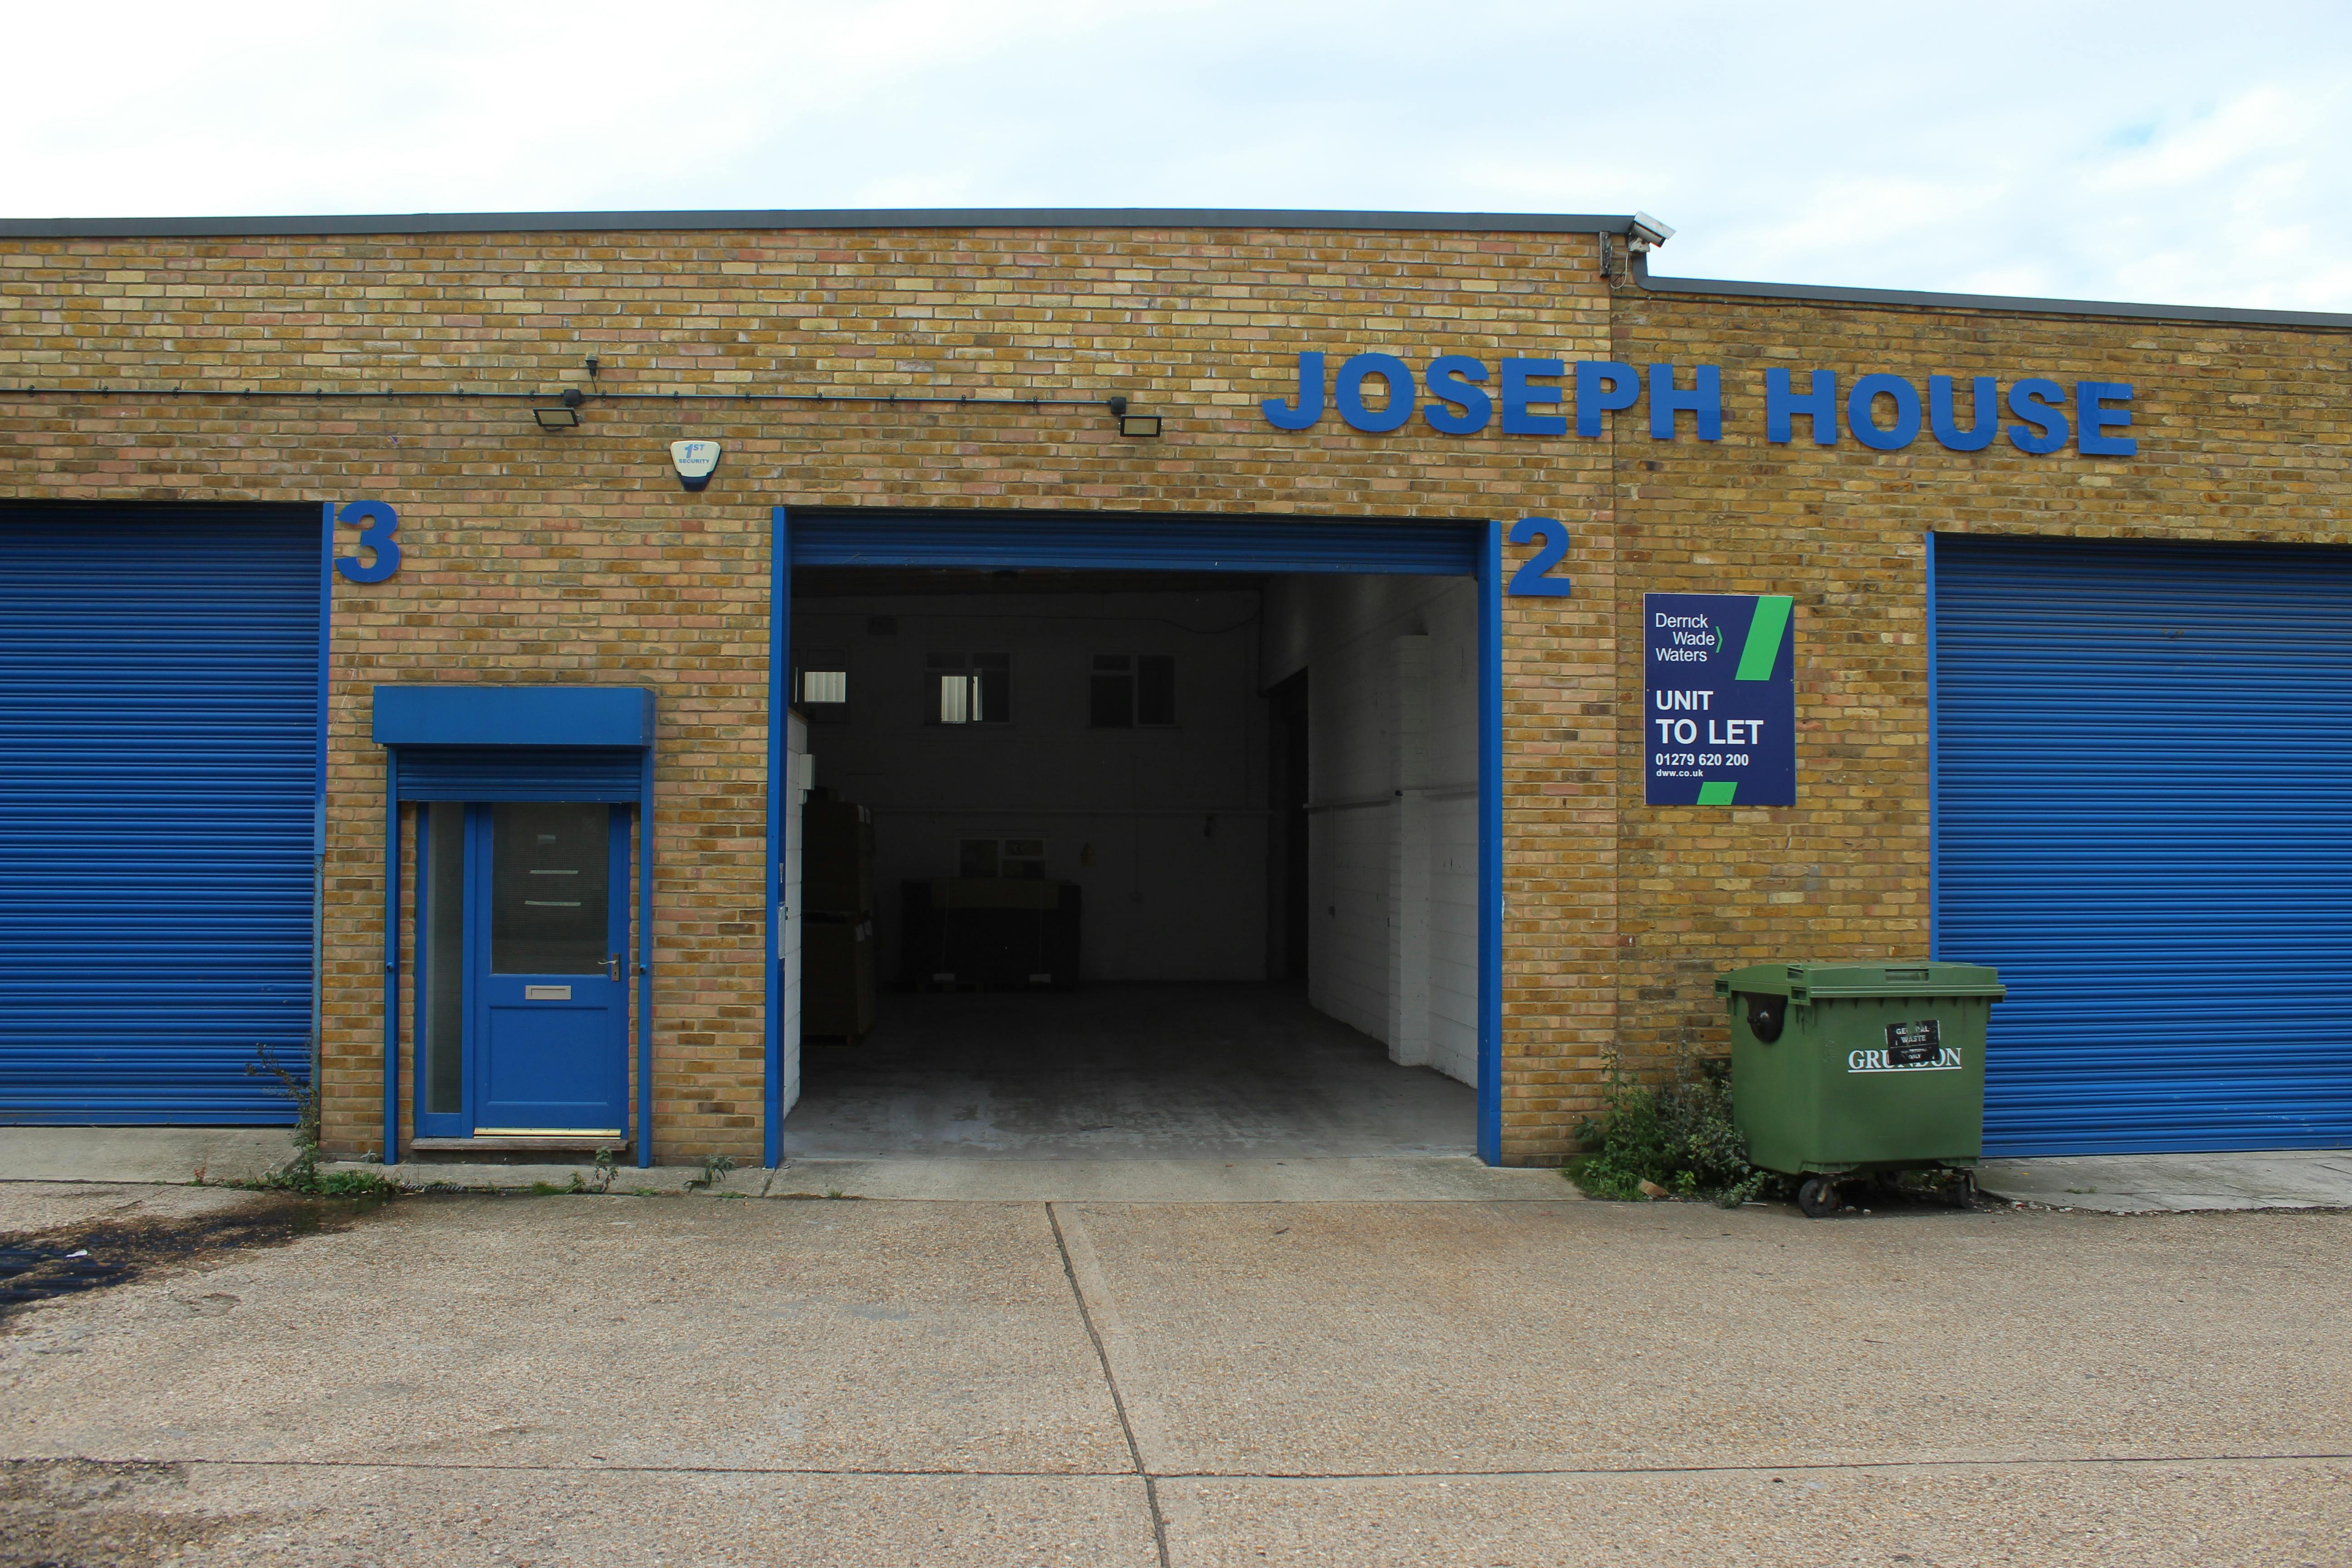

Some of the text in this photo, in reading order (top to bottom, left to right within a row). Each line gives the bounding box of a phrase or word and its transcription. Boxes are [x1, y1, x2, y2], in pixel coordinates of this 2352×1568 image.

[1261, 352, 2137, 456] JOSEPH HOUSE
[684, 443, 705, 458] 1ST
[335, 500, 400, 583] 3
[1508, 517, 1570, 596] 2
[1656, 612, 1709, 628] Derrick
[1672, 631, 1715, 646] Wade
[1655, 647, 1708, 662] Waters
[1656, 690, 1714, 710] UNIT
[1656, 719, 1764, 745] TO LET
[1656, 753, 1749, 766] 01279 620 200
[1656, 769, 1704, 777] dww.co.uk
[1901, 1034, 1927, 1043] WASTE
